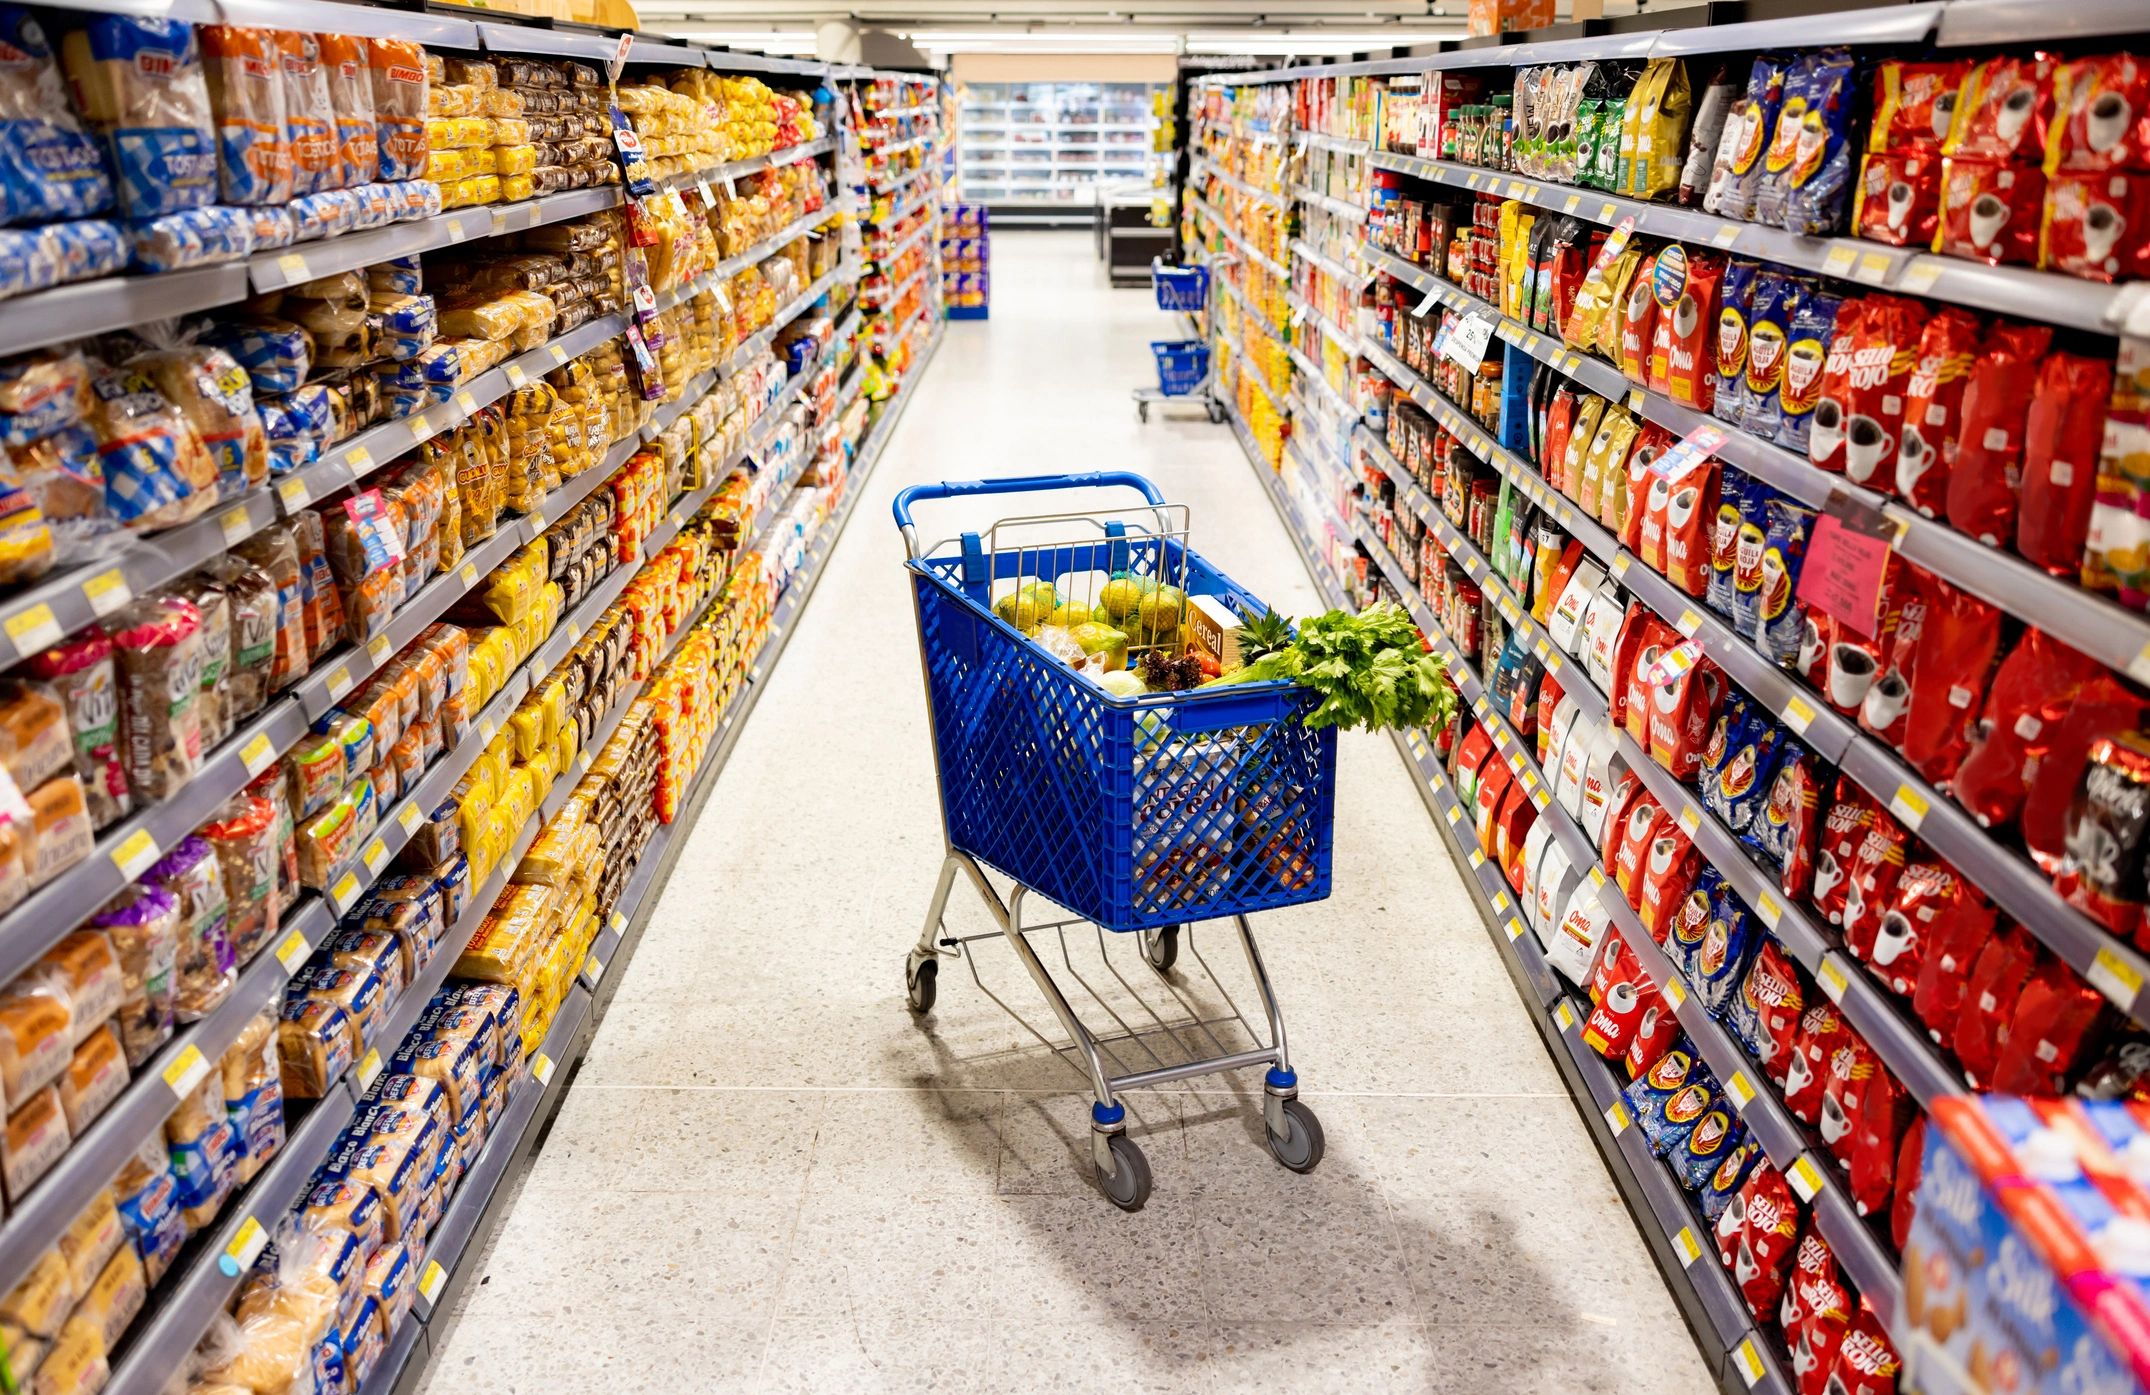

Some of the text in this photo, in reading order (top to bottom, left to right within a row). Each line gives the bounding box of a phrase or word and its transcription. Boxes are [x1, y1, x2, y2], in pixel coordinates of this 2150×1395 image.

[390, 68, 424, 84] BIMBO
[1669, 345, 1694, 371] Oma
[1853, 345, 1898, 365] SELLO
[1564, 593, 1580, 612] Oma
[1188, 609, 1222, 657] Cereal
[1628, 682, 1646, 713] Oma
[1651, 714, 1675, 747] Oma
[1618, 841, 1637, 873] Oma
[1643, 872, 1662, 906] Oma
[1568, 909, 1592, 933] Oma
[1594, 966, 1609, 992] Oma
[1760, 972, 1789, 996] SELLO
[1757, 985, 1783, 1008] ROJO
[1591, 1009, 1621, 1040] Oma
[1629, 1033, 1645, 1066] Oma
[1840, 1336, 1879, 1376] ROJO
[1850, 1328, 1893, 1366] SELLO
